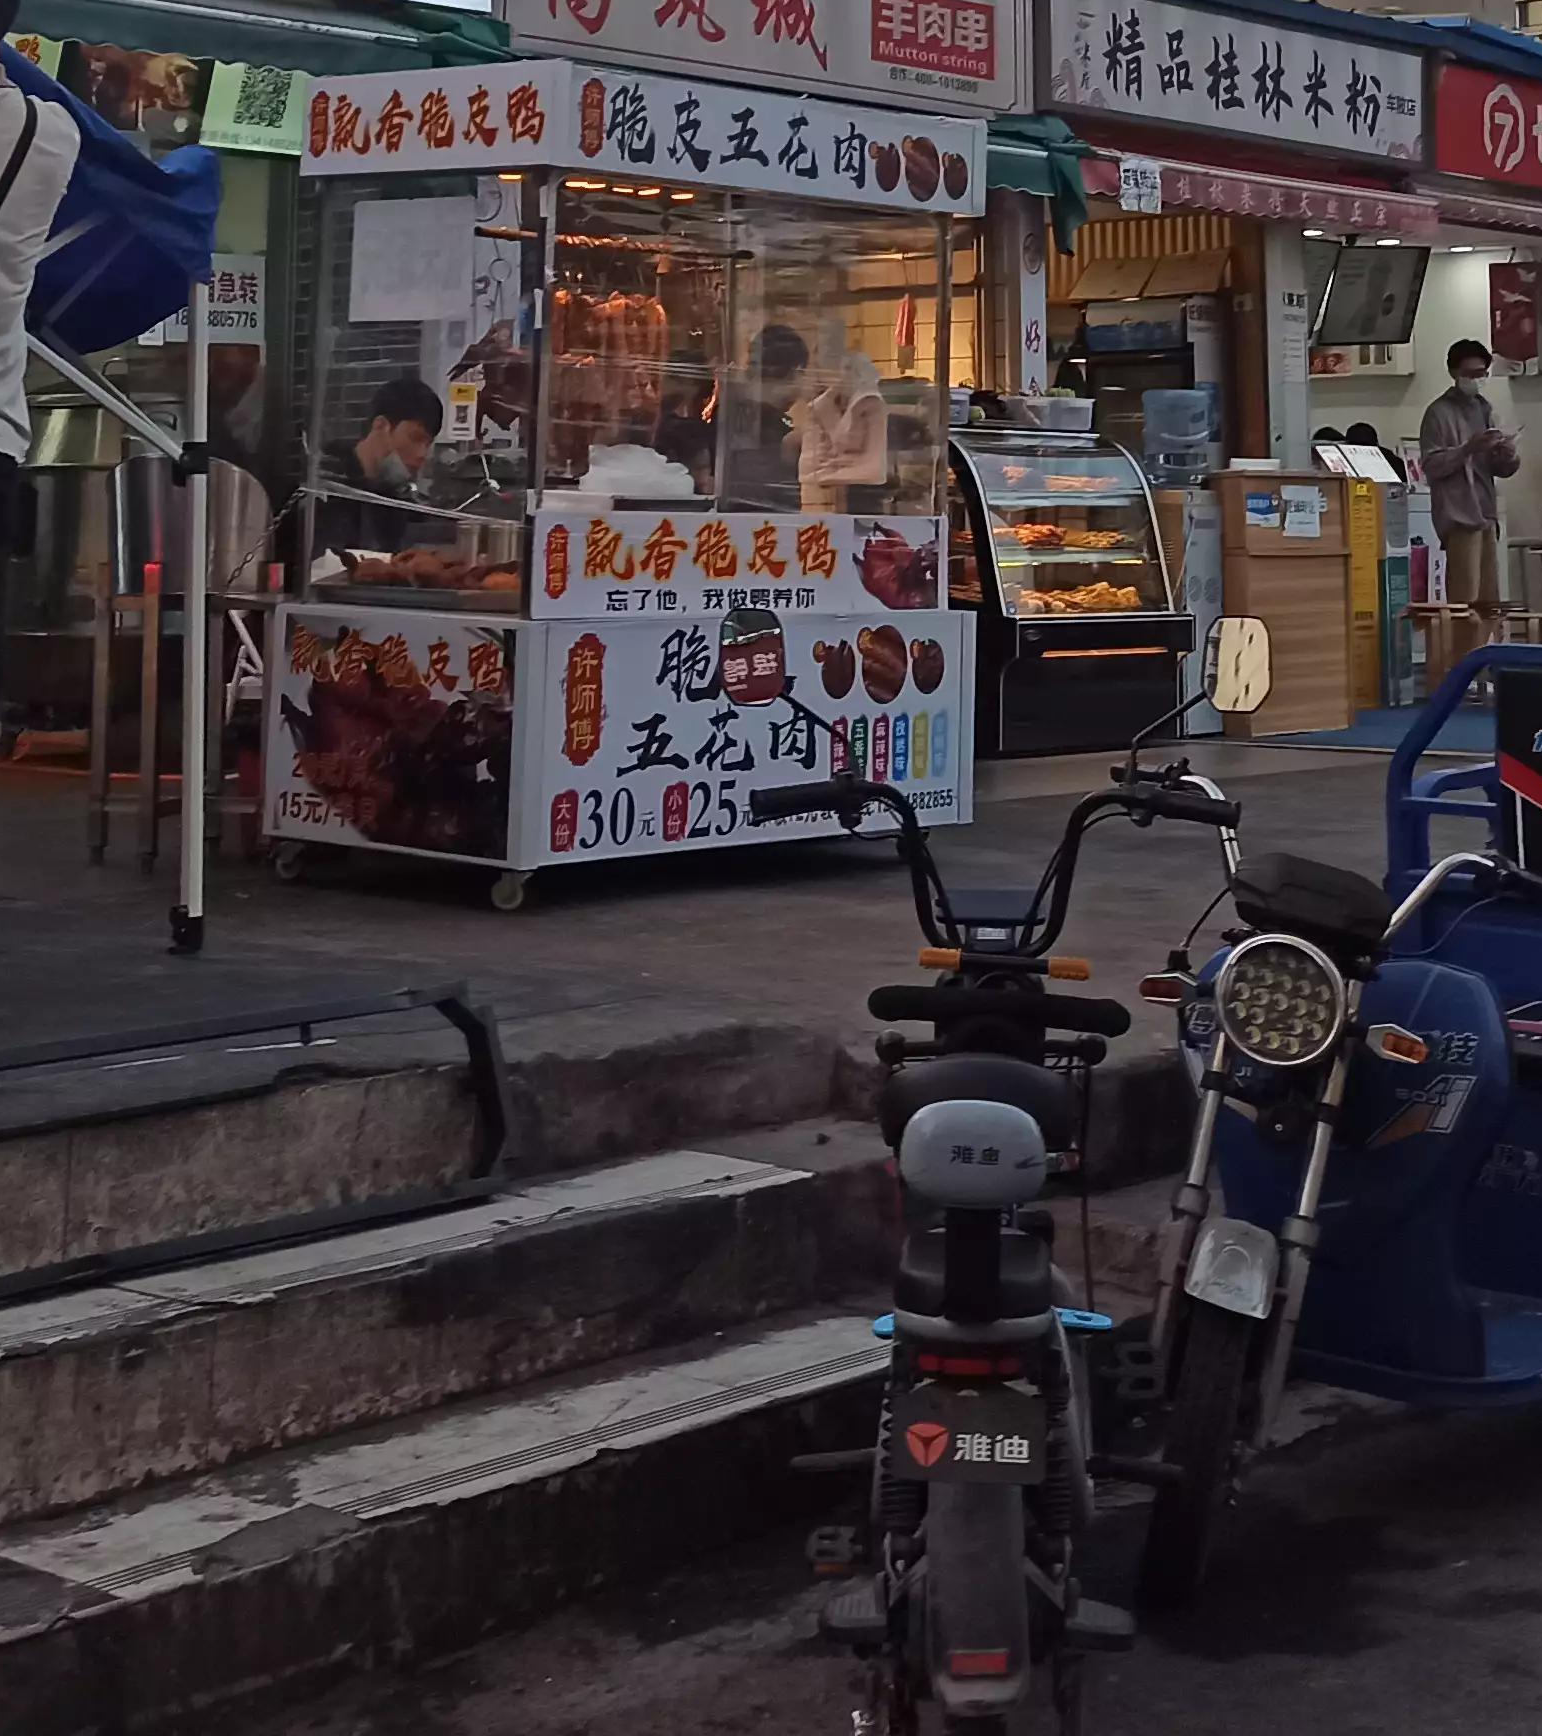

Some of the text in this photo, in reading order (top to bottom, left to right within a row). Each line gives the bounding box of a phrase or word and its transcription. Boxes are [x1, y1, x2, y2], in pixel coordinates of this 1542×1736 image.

[879, 40, 988, 75] Mutton string
[1101, 8, 1382, 138] 精品桂林米粉
[331, 81, 546, 155] 飘香脆皮鸭
[607, 82, 868, 190] 脆皮五花肉
[584, 517, 838, 580] 飘香脆皮鸭
[290, 623, 506, 694] 飘香脆皮鸭
[569, 648, 599, 751] 许师傅
[616, 705, 818, 778] 五花肉
[554, 799, 572, 853] 大份
[578, 787, 657, 850] 30元
[666, 788, 683, 835] 小份
[953, 1432, 1032, 1465] 雅迪
